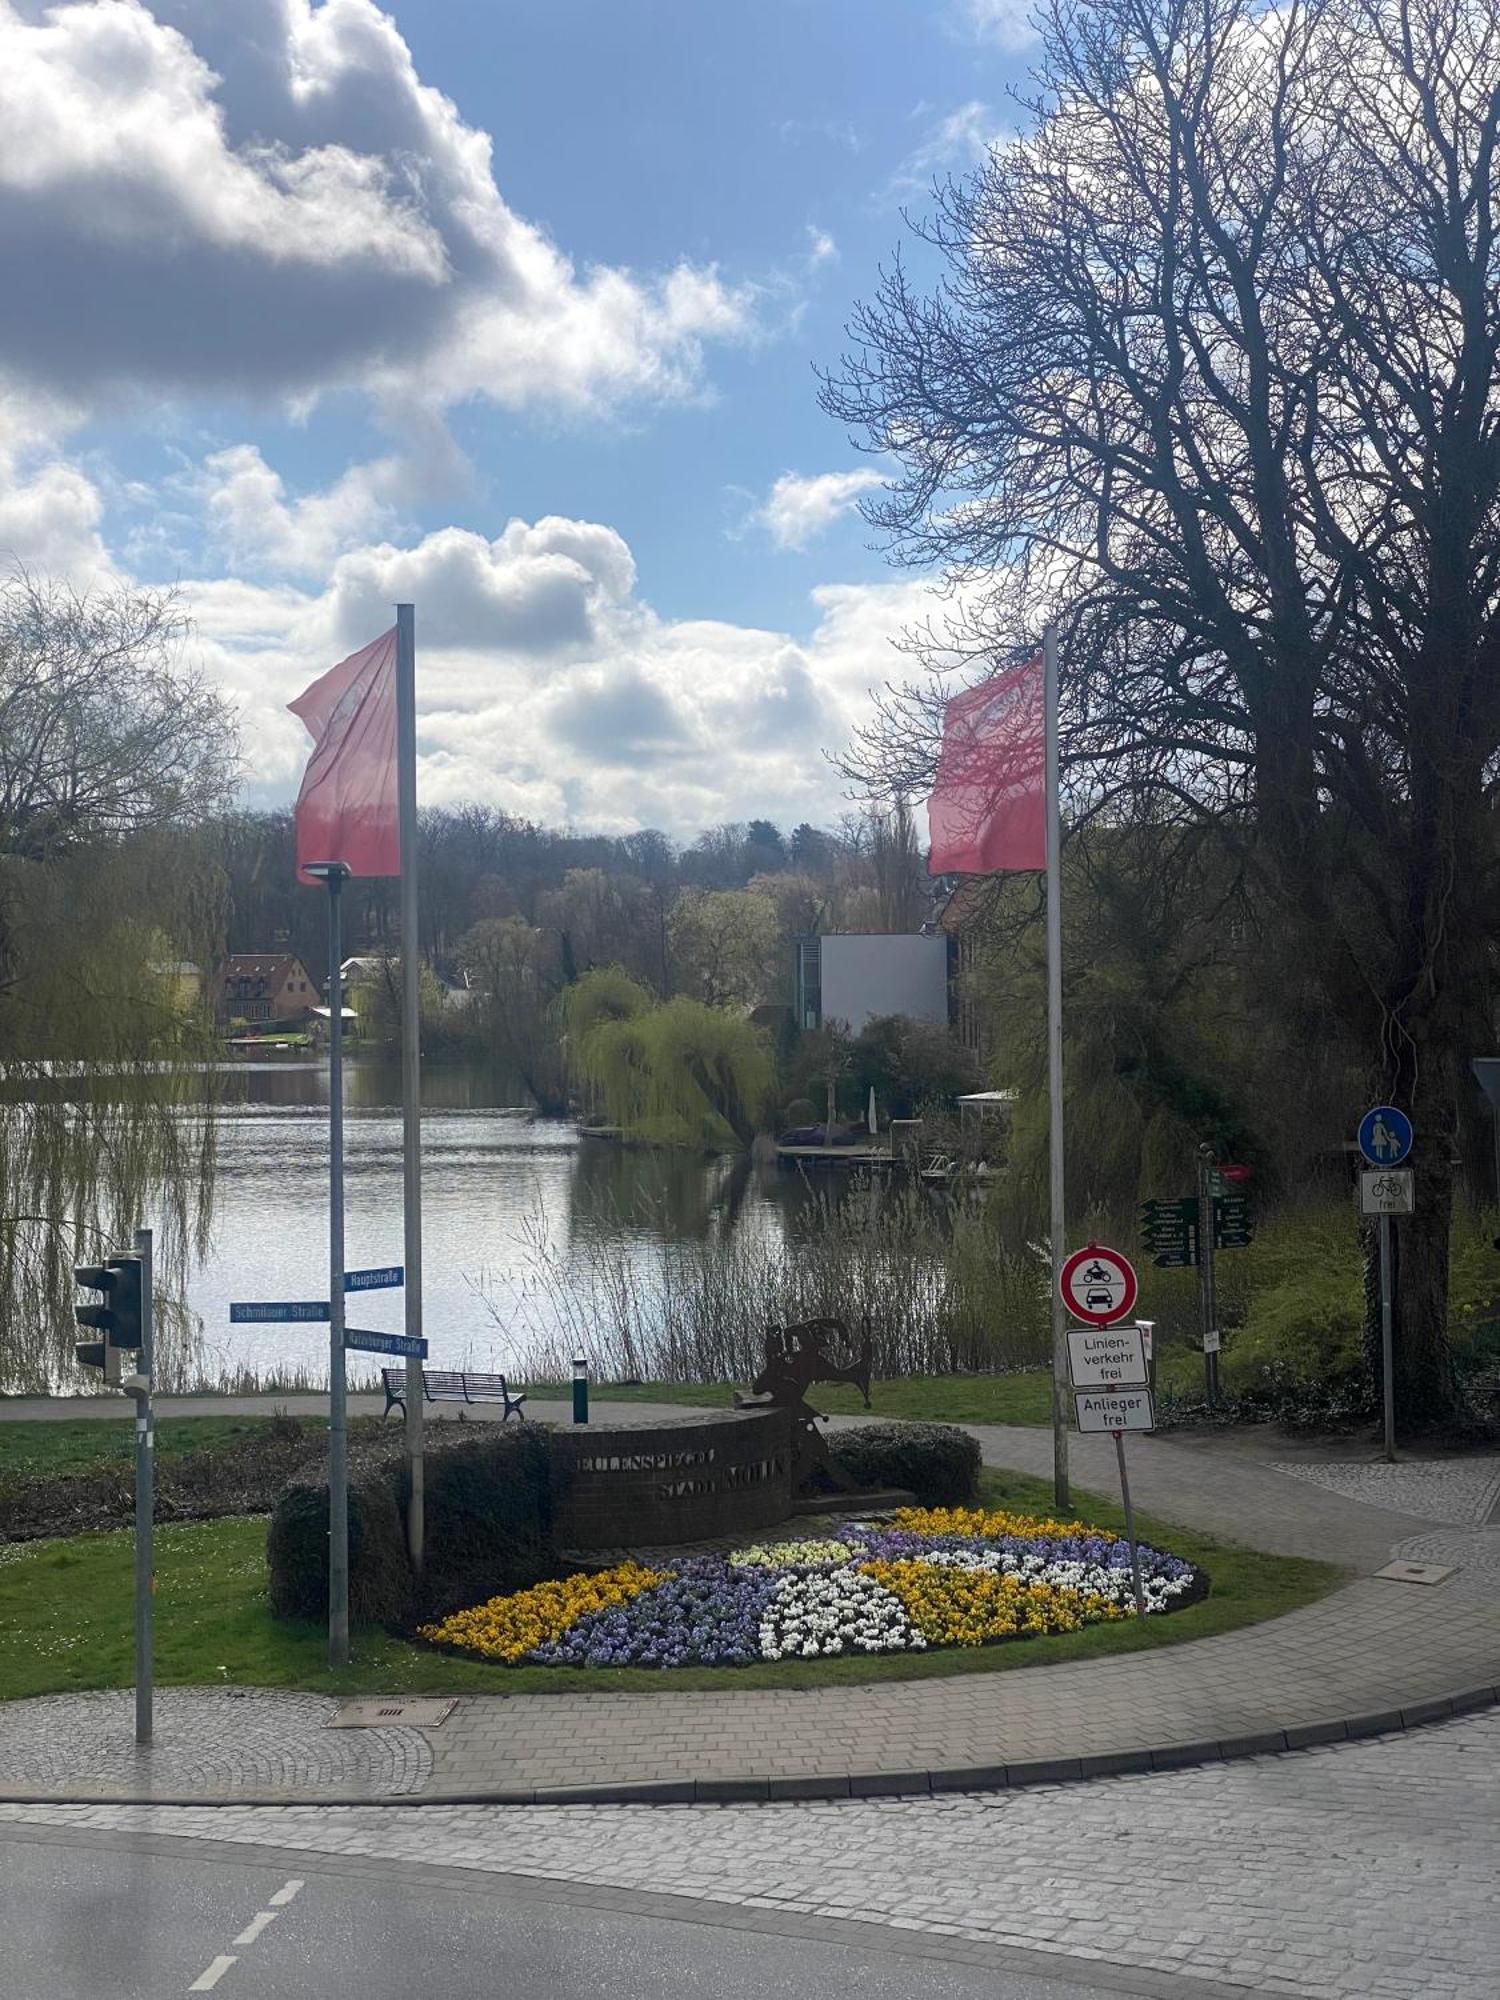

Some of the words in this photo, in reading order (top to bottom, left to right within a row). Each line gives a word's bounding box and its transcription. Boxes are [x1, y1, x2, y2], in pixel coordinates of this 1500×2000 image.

[1379, 1199, 1396, 1209] frei
[351, 1269, 399, 1287] Hauptstraße
[292, 1306, 324, 1318] Straße
[396, 1339, 421, 1354] Straße
[1084, 1339, 1130, 1350] Linien-
[1083, 1351, 1135, 1365] verkehr
[1100, 1367, 1122, 1380] frei
[1084, 1398, 1142, 1413] Anlieger
[1103, 1414, 1128, 1426] frei
